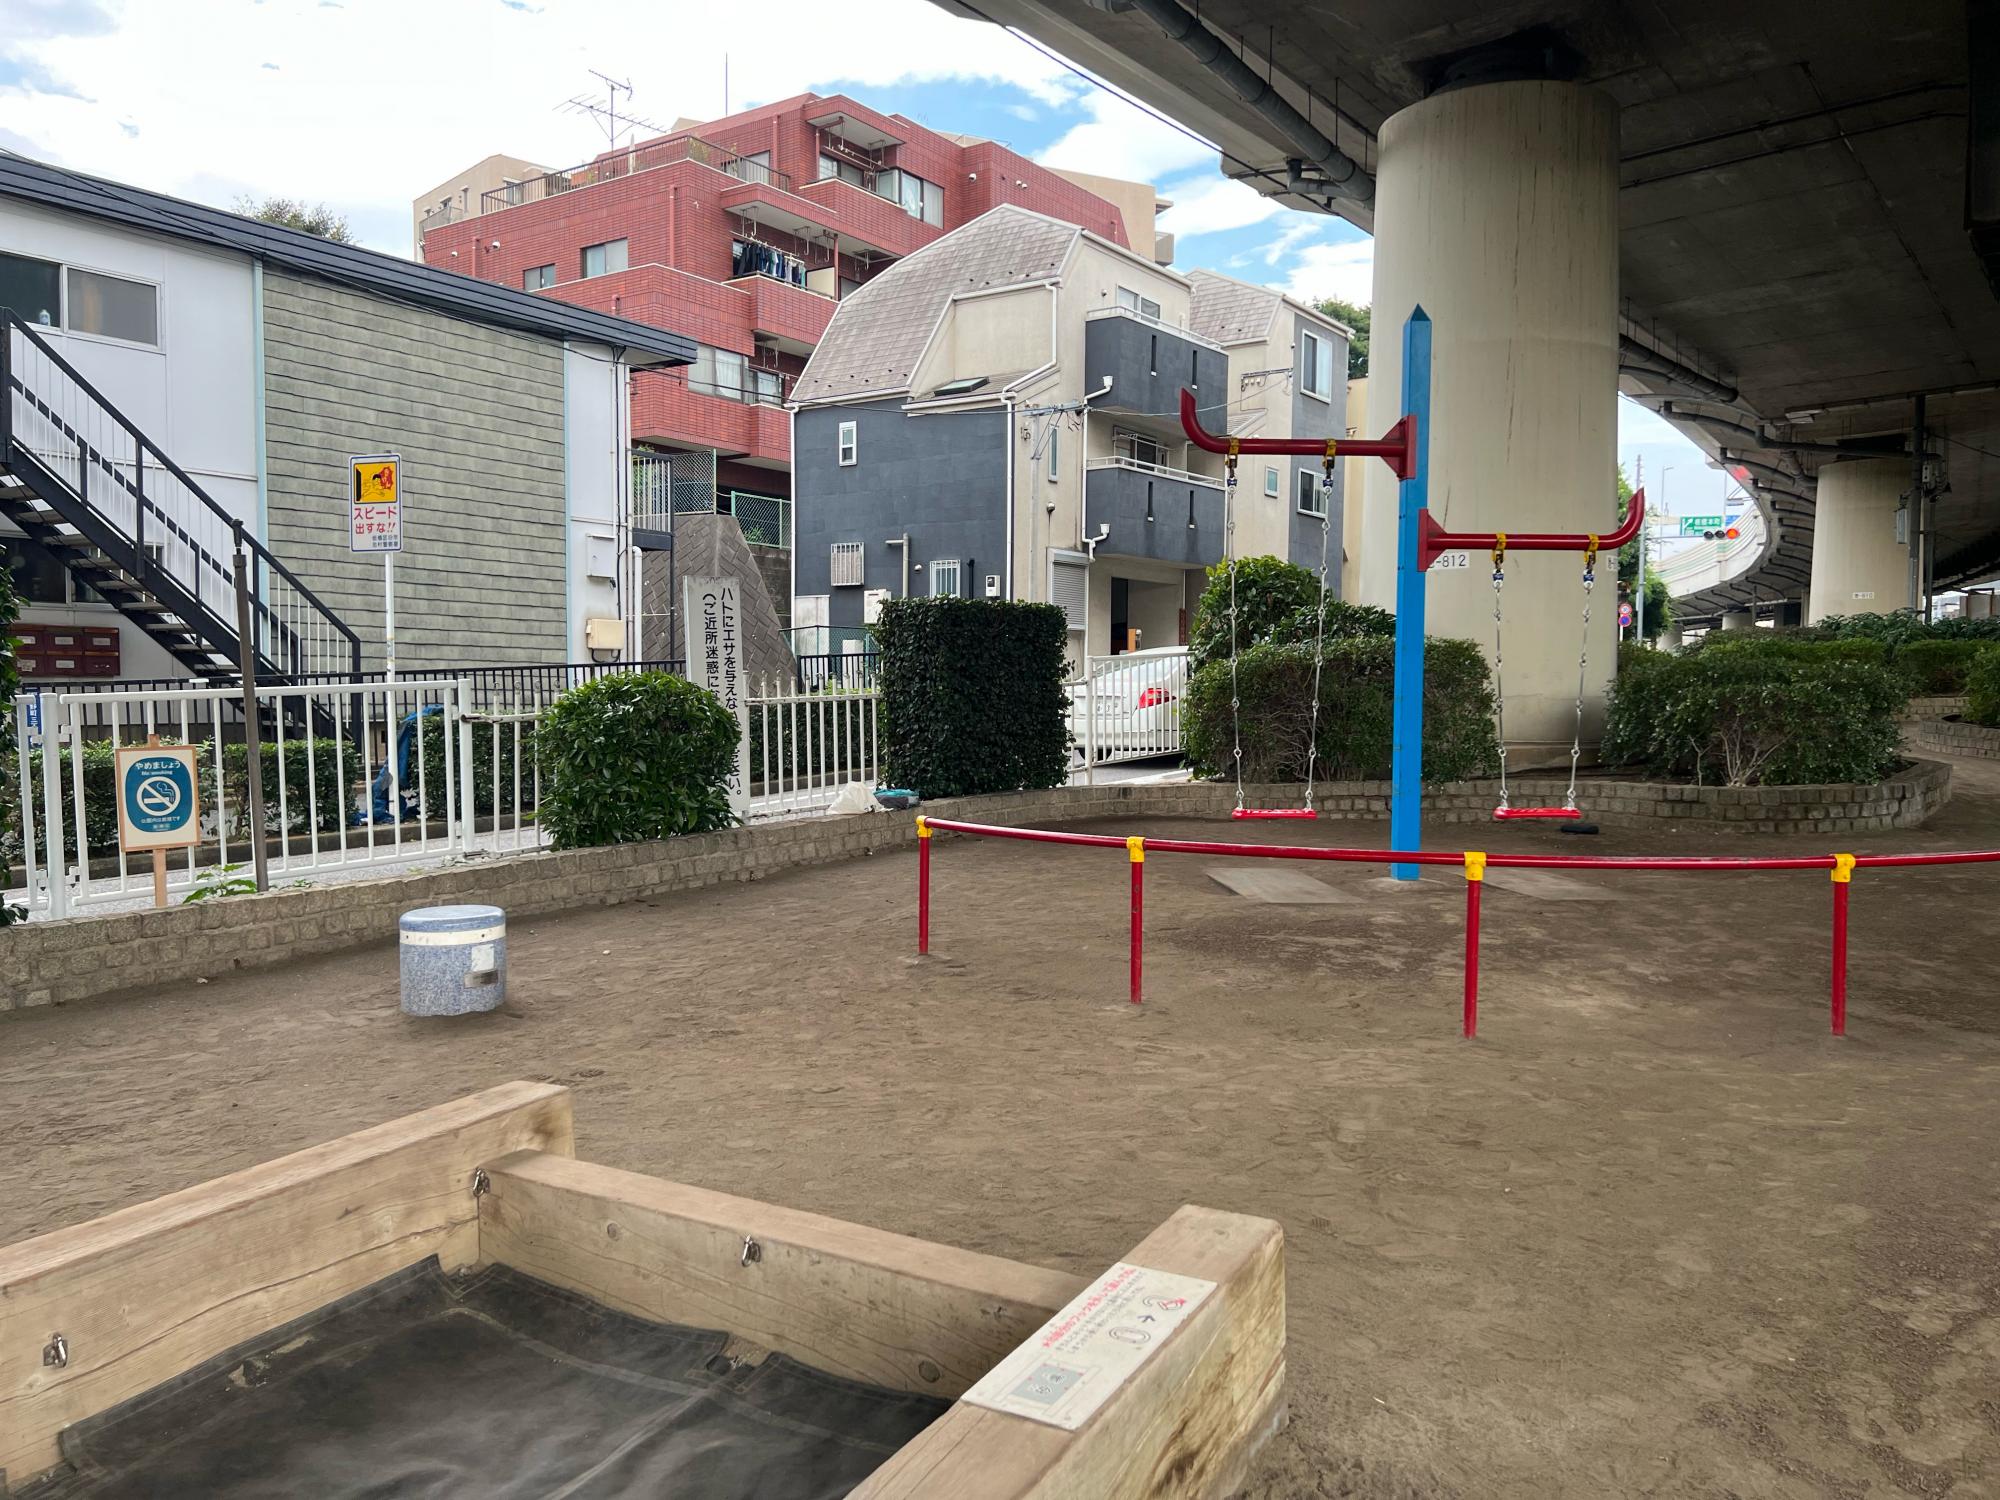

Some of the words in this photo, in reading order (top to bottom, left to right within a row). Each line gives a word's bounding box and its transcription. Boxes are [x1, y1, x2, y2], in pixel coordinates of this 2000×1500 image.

[353, 506, 398, 520] スピード
[1429, 554, 1467, 568] -812
[135, 761, 181, 770] やめましょう
